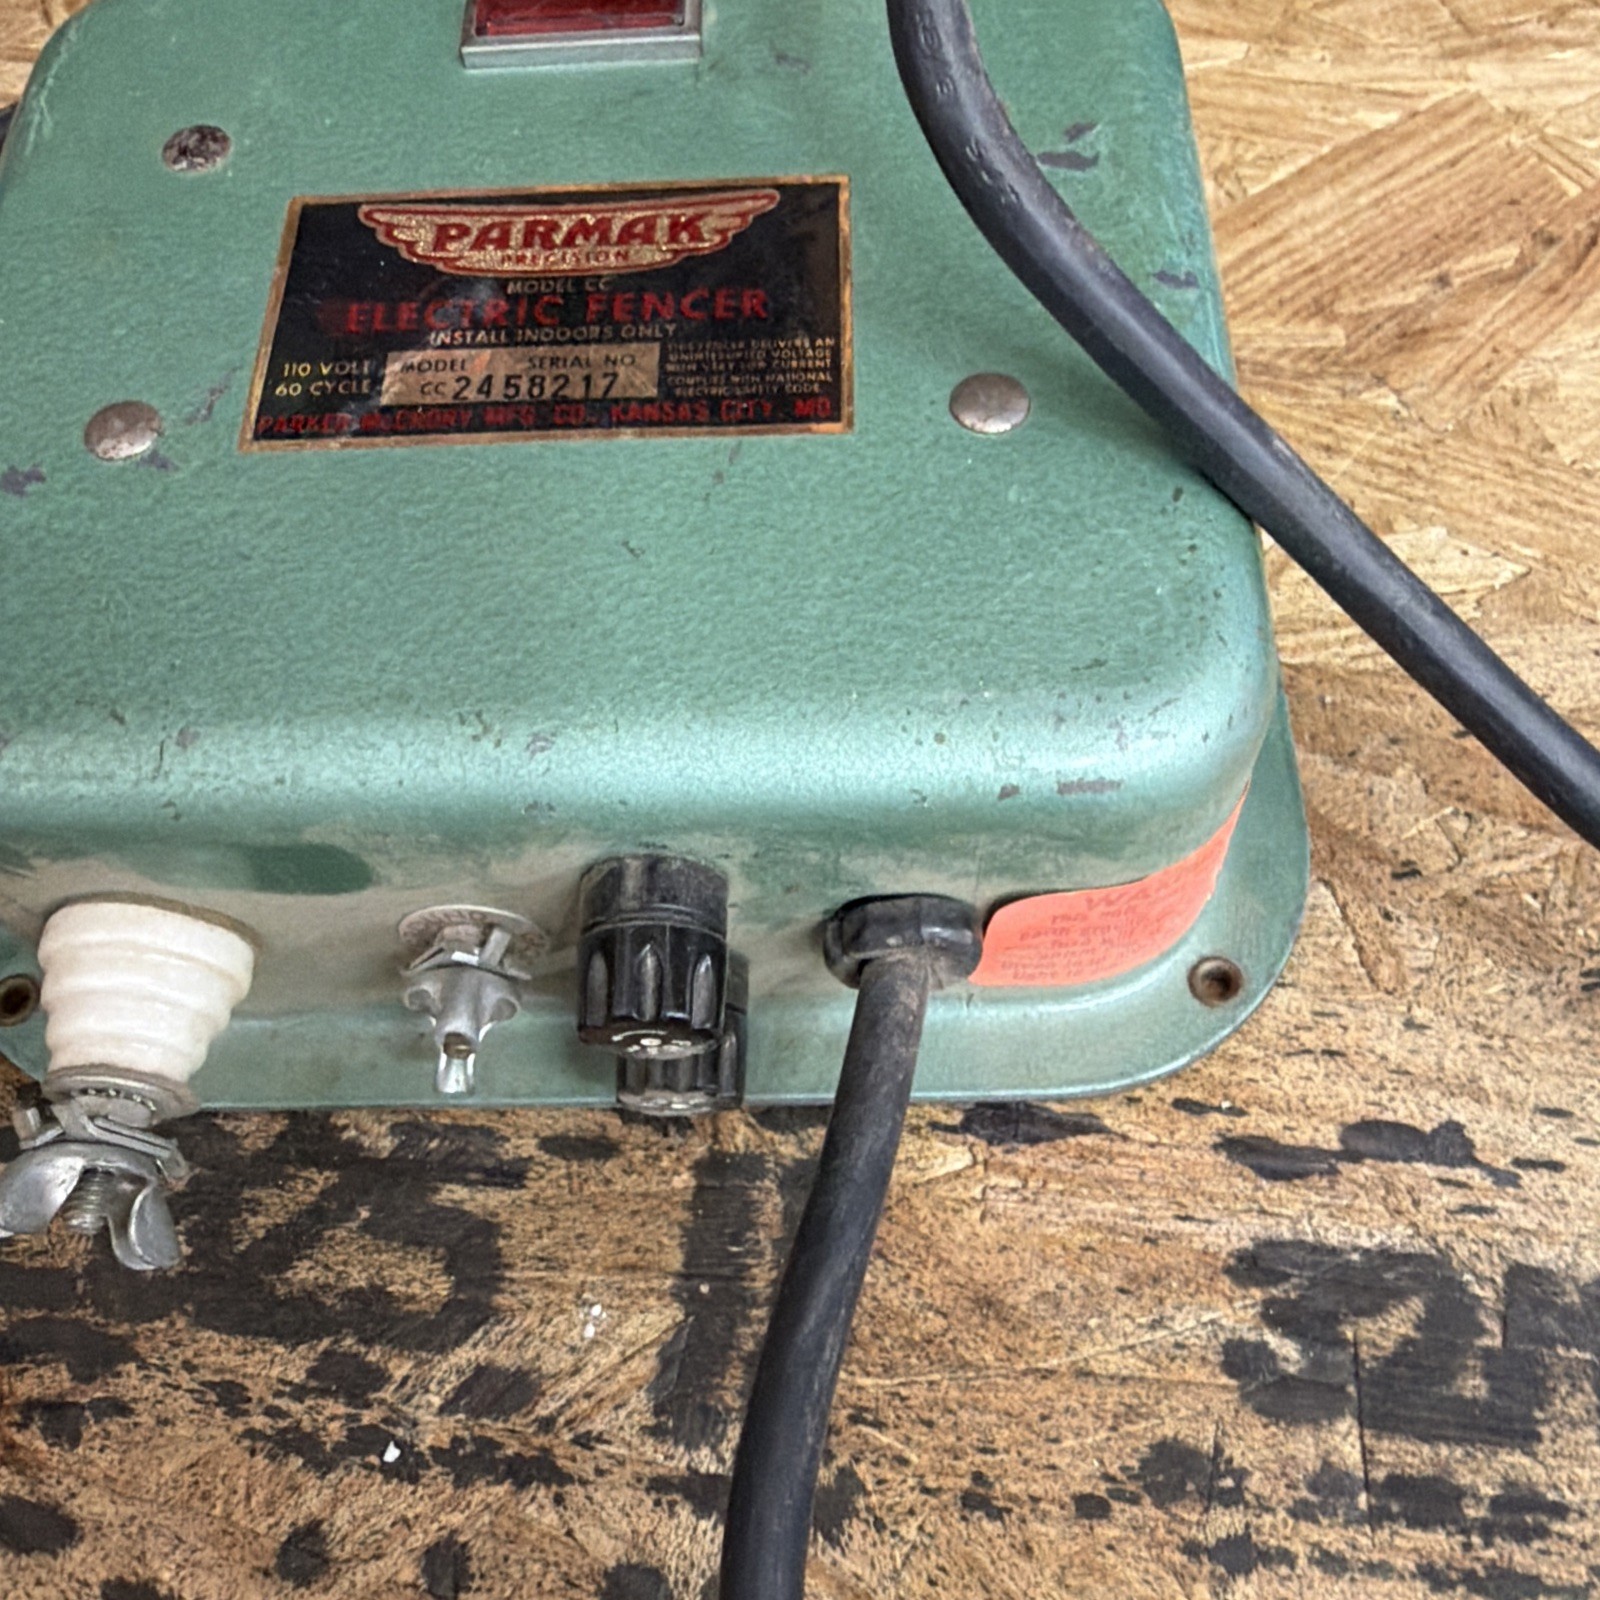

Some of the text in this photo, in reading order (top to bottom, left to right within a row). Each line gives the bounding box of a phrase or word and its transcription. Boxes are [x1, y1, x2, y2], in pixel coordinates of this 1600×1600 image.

[433, 214, 706, 251] PARMAK
[506, 276, 613, 295] MODEL CC
[346, 284, 769, 334] ELECTRIC FENCER
[430, 322, 677, 346] INSTALL INDOORS ONLY
[283, 359, 372, 377] 110 VOLT
[401, 358, 467, 374] MODEL
[527, 353, 592, 371] SERIAL
[275, 378, 371, 396] 60 CYCLE
[420, 381, 445, 396] CC
[610, 400, 710, 422] KANSAS
